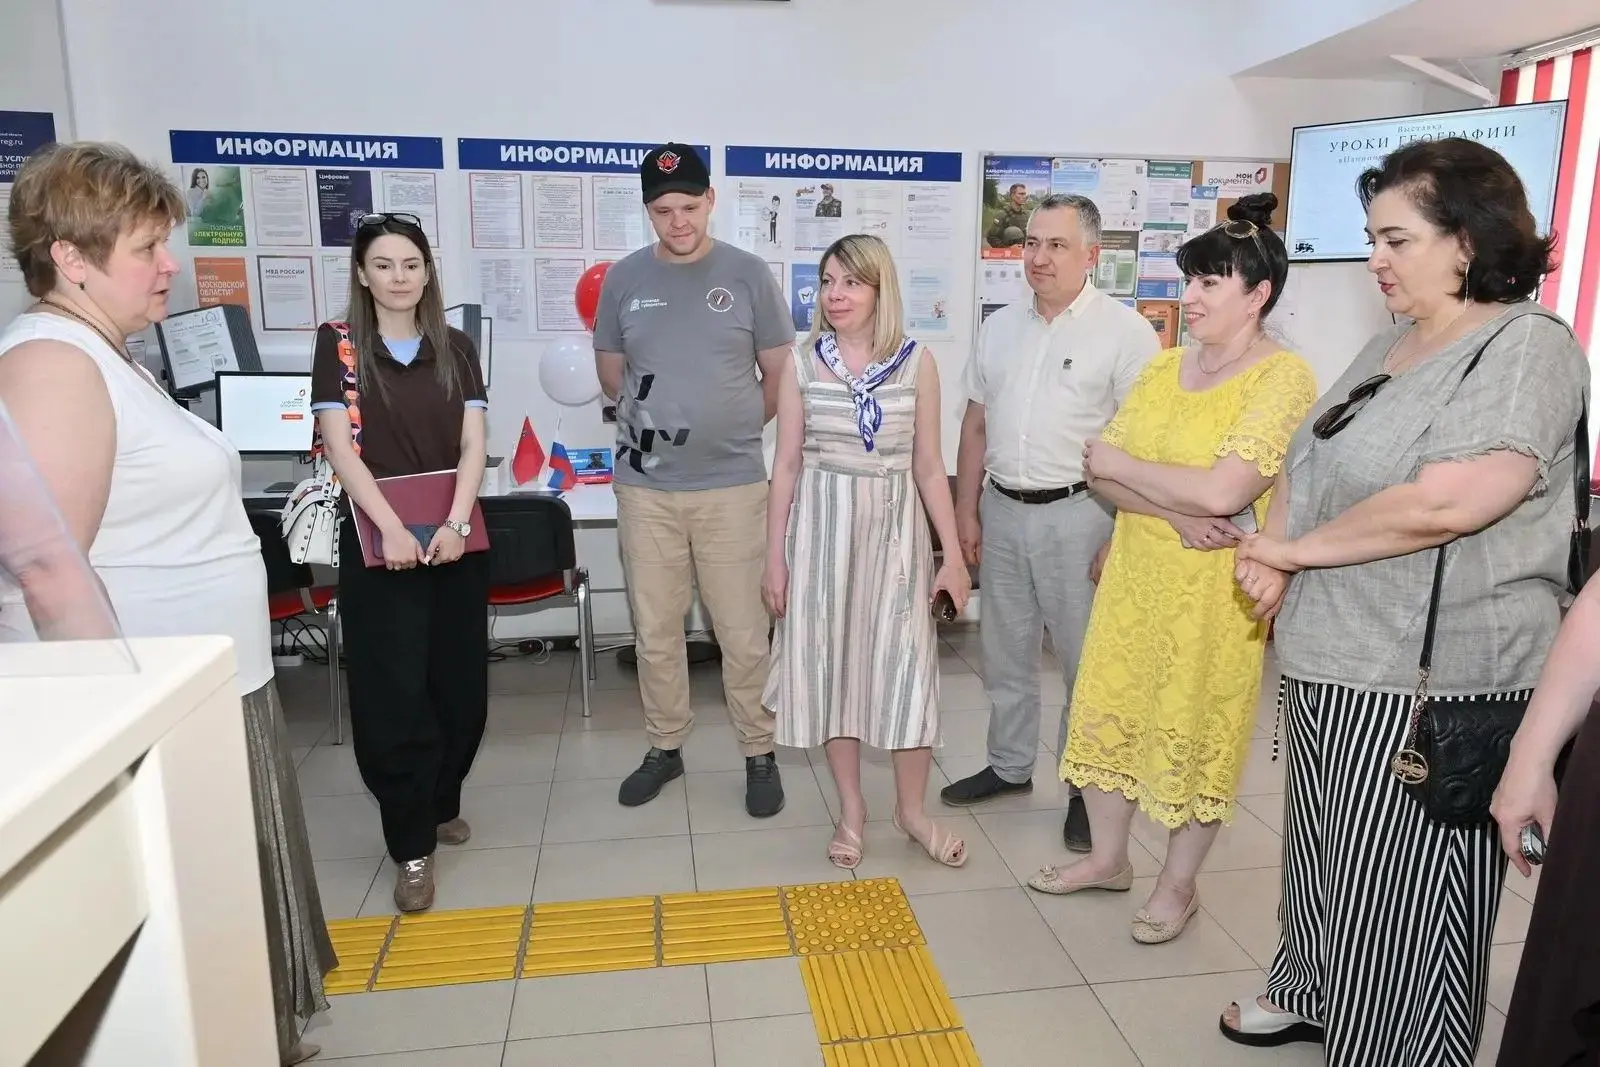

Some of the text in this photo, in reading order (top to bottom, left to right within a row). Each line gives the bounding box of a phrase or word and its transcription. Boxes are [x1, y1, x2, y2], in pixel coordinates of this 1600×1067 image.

[1397, 124, 1442, 133] Выставка
[216, 137, 398, 161] ИНФОРМАЦИЯ
[1330, 137, 1388, 152] УРОКИ
[765, 152, 923, 175] ИНФОРМАЦИЯ
[198, 280, 245, 288] МОСКОВСКОЙ
[199, 288, 233, 296] ОБЛАСТИ?
